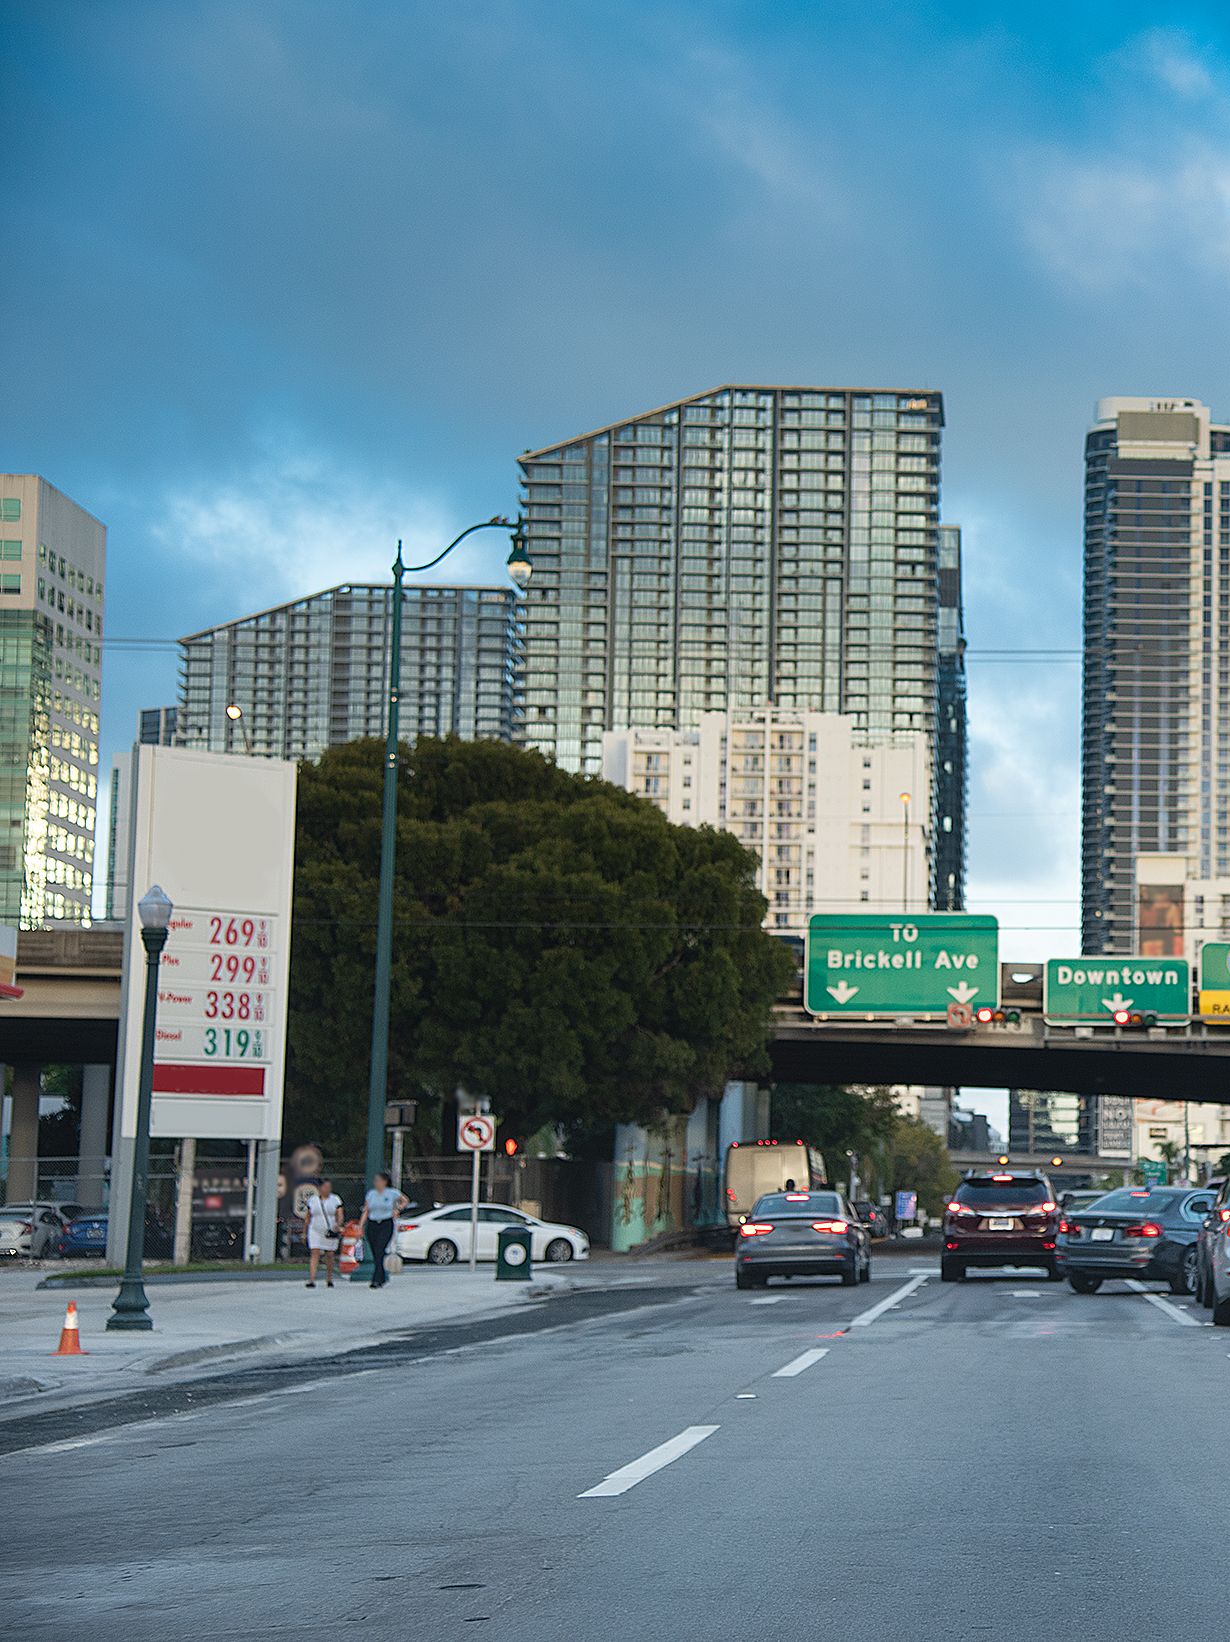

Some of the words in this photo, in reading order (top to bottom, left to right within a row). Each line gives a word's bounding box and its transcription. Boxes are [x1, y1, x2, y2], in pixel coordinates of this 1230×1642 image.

[210, 916, 255, 947] 269
[889, 923, 919, 942] TO
[210, 953, 256, 984] 299
[827, 949, 922, 969] Brickell
[934, 950, 979, 969] Ave
[1057, 965, 1178, 985] Downtown
[205, 991, 251, 1021] 338
[203, 1028, 251, 1057] 319
